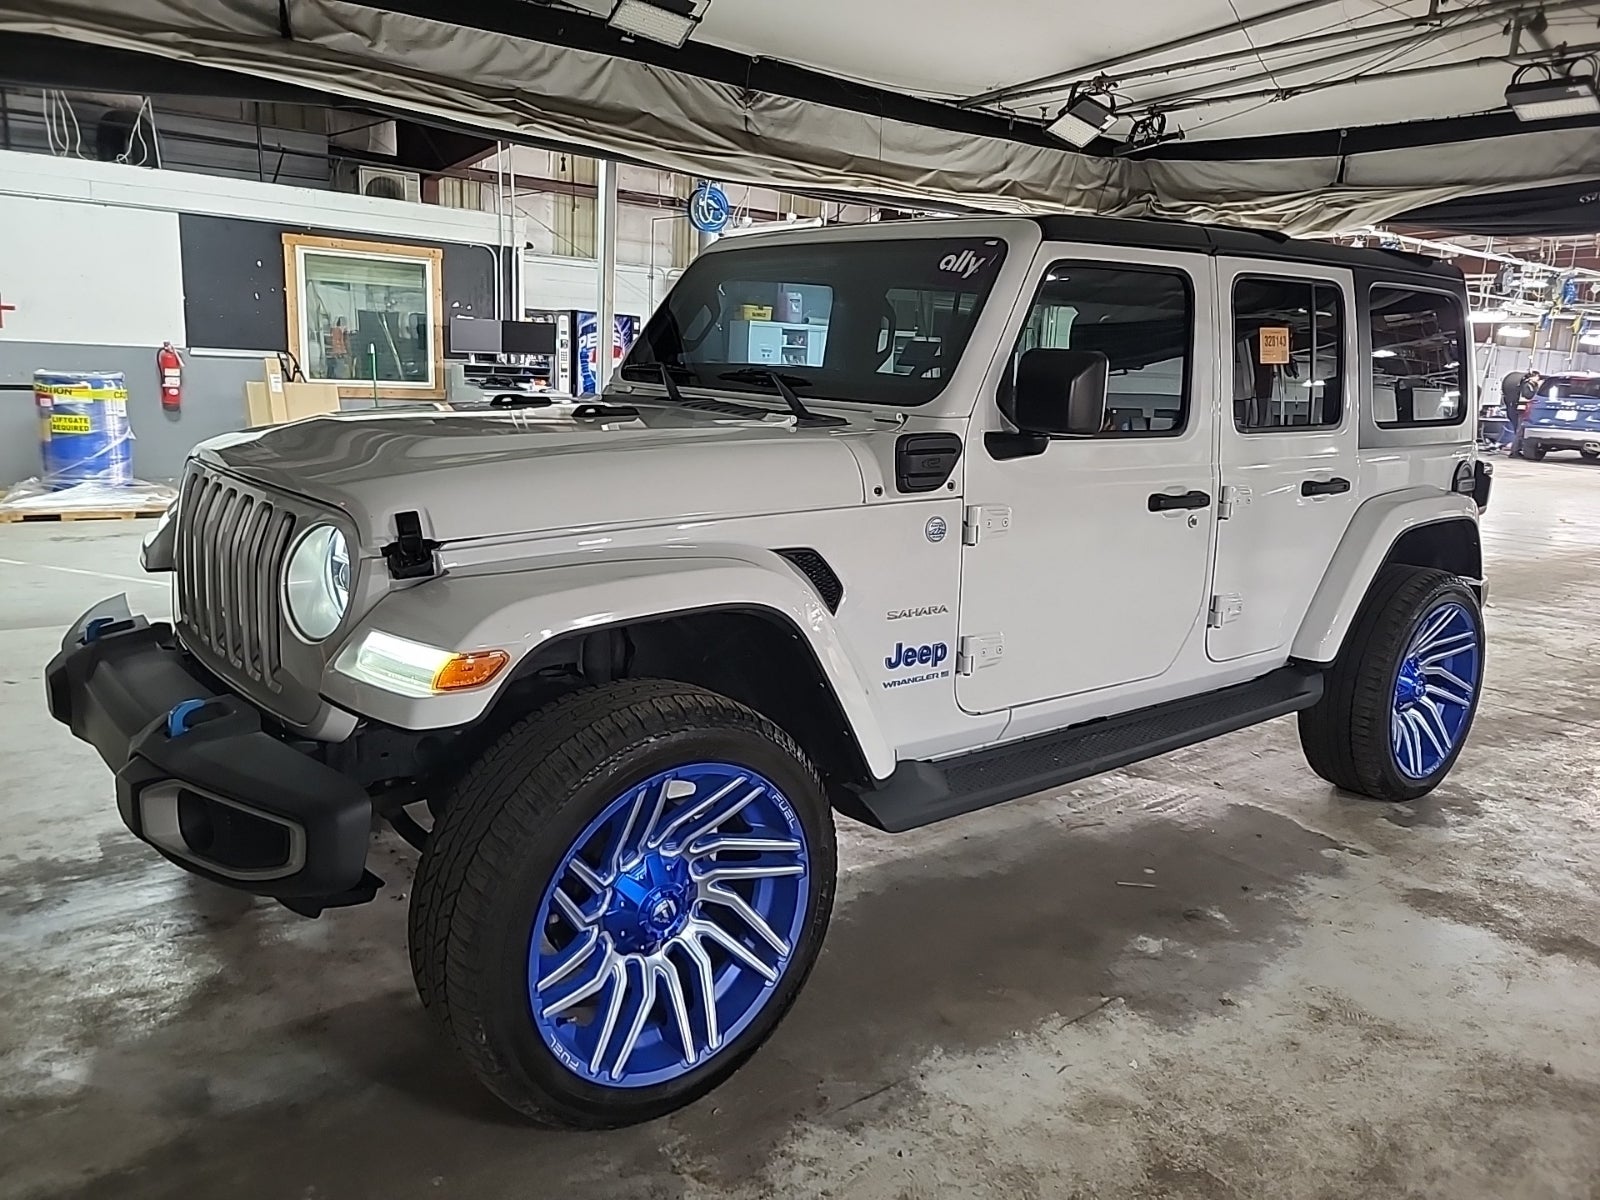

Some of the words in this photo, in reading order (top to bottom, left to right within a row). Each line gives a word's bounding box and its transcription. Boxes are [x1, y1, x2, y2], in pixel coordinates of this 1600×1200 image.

[939, 250, 986, 278] ally
[886, 605, 948, 620] SAHARA
[885, 642, 947, 670] Jeep
[883, 672, 939, 689] WRANGLER
[772, 793, 795, 829] FUEL
[550, 1033, 579, 1070] FUEL
